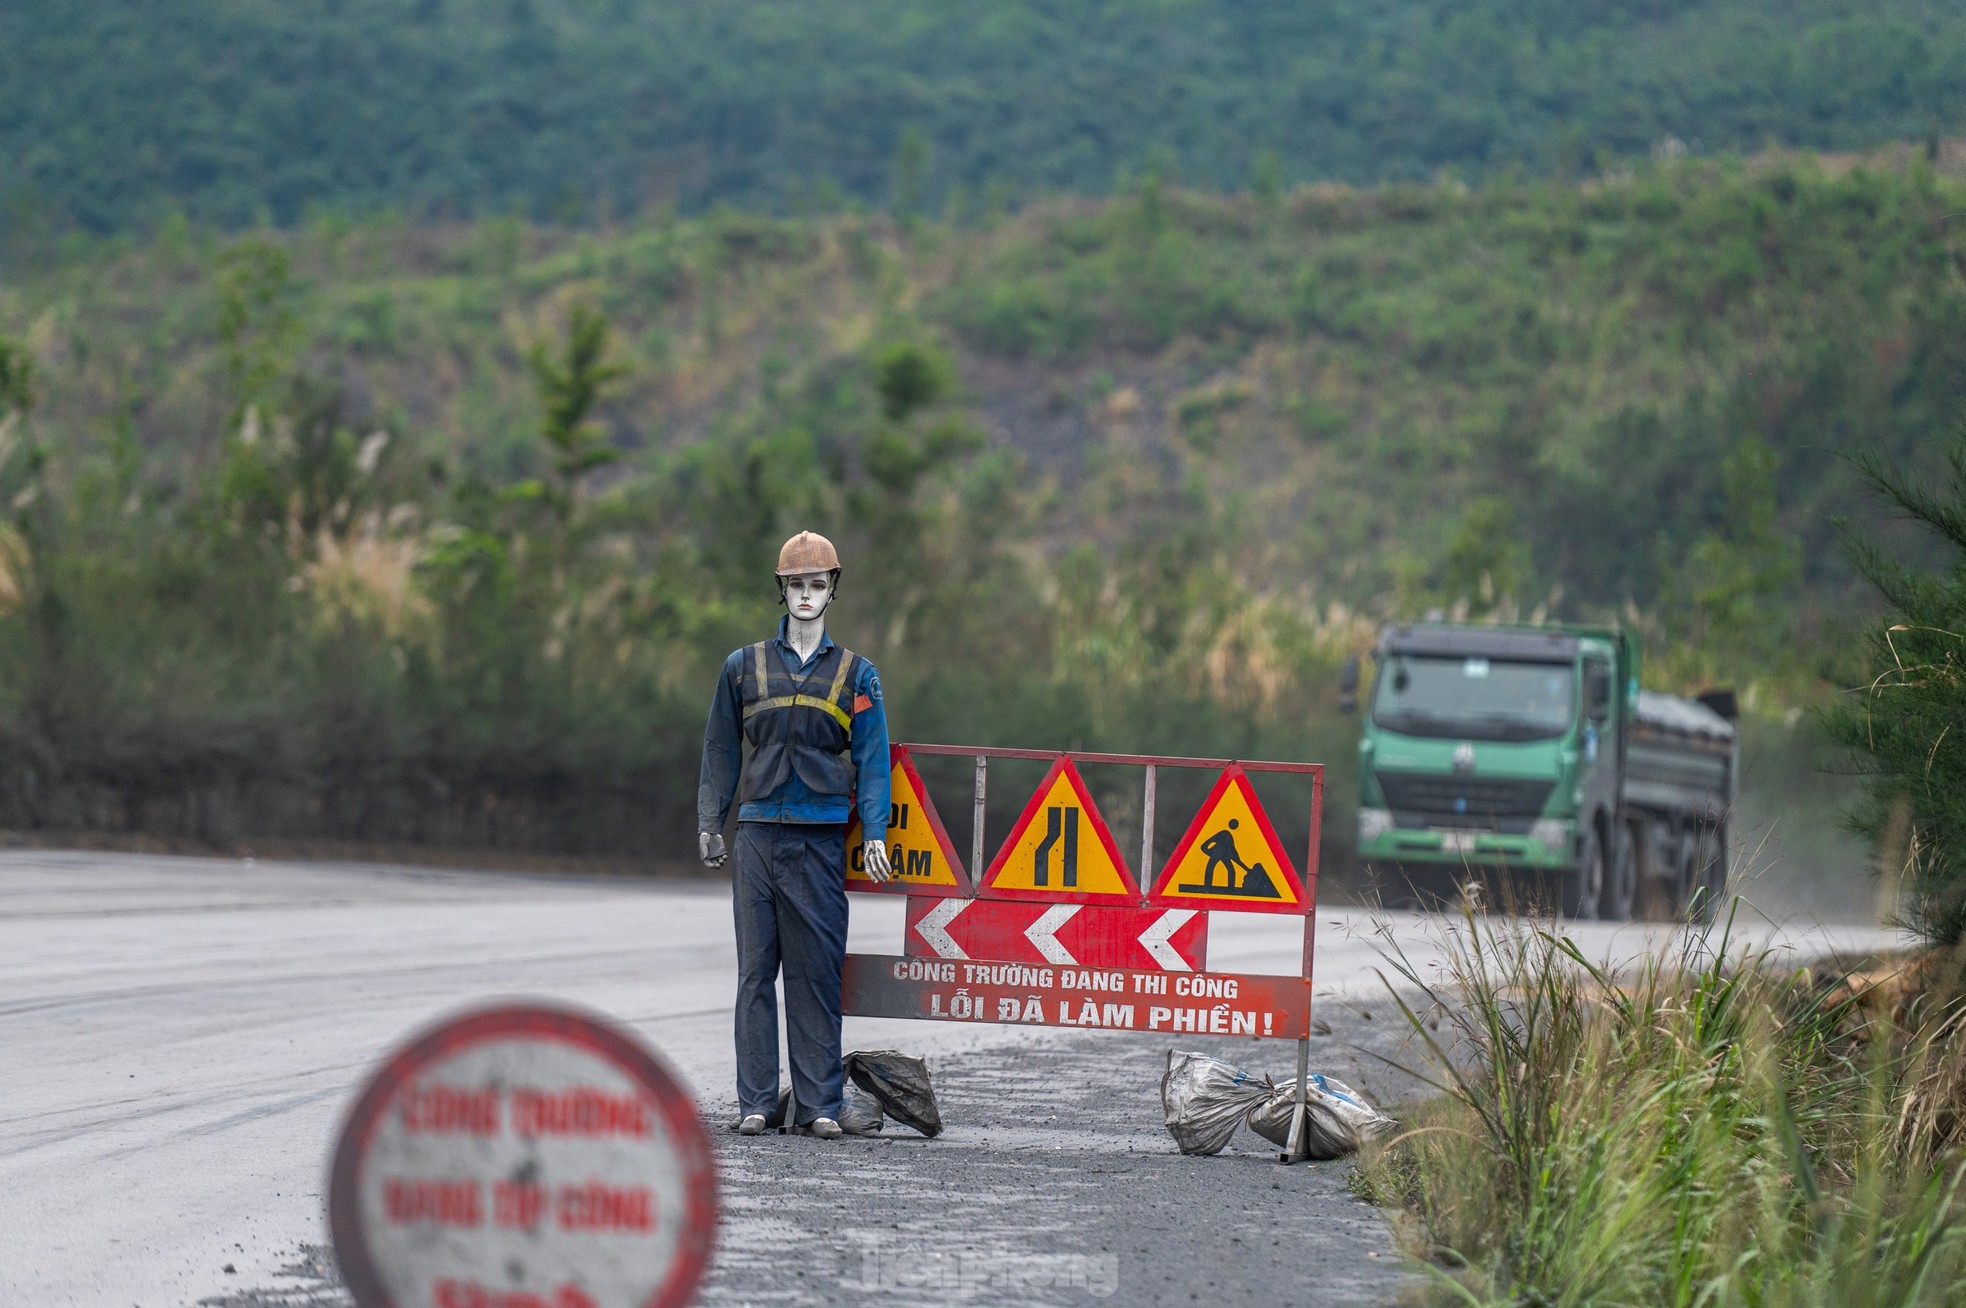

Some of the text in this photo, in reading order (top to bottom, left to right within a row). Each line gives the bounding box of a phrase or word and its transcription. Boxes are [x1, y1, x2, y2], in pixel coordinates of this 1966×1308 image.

[851, 843, 932, 879] CẬM
[894, 959, 1238, 999] CÔNG TRƯỜNG ĐANG THI CÔNG
[931, 988, 984, 1019] LỖI
[998, 995, 1045, 1023] ĐÃ
[1059, 997, 1134, 1028] LÀM
